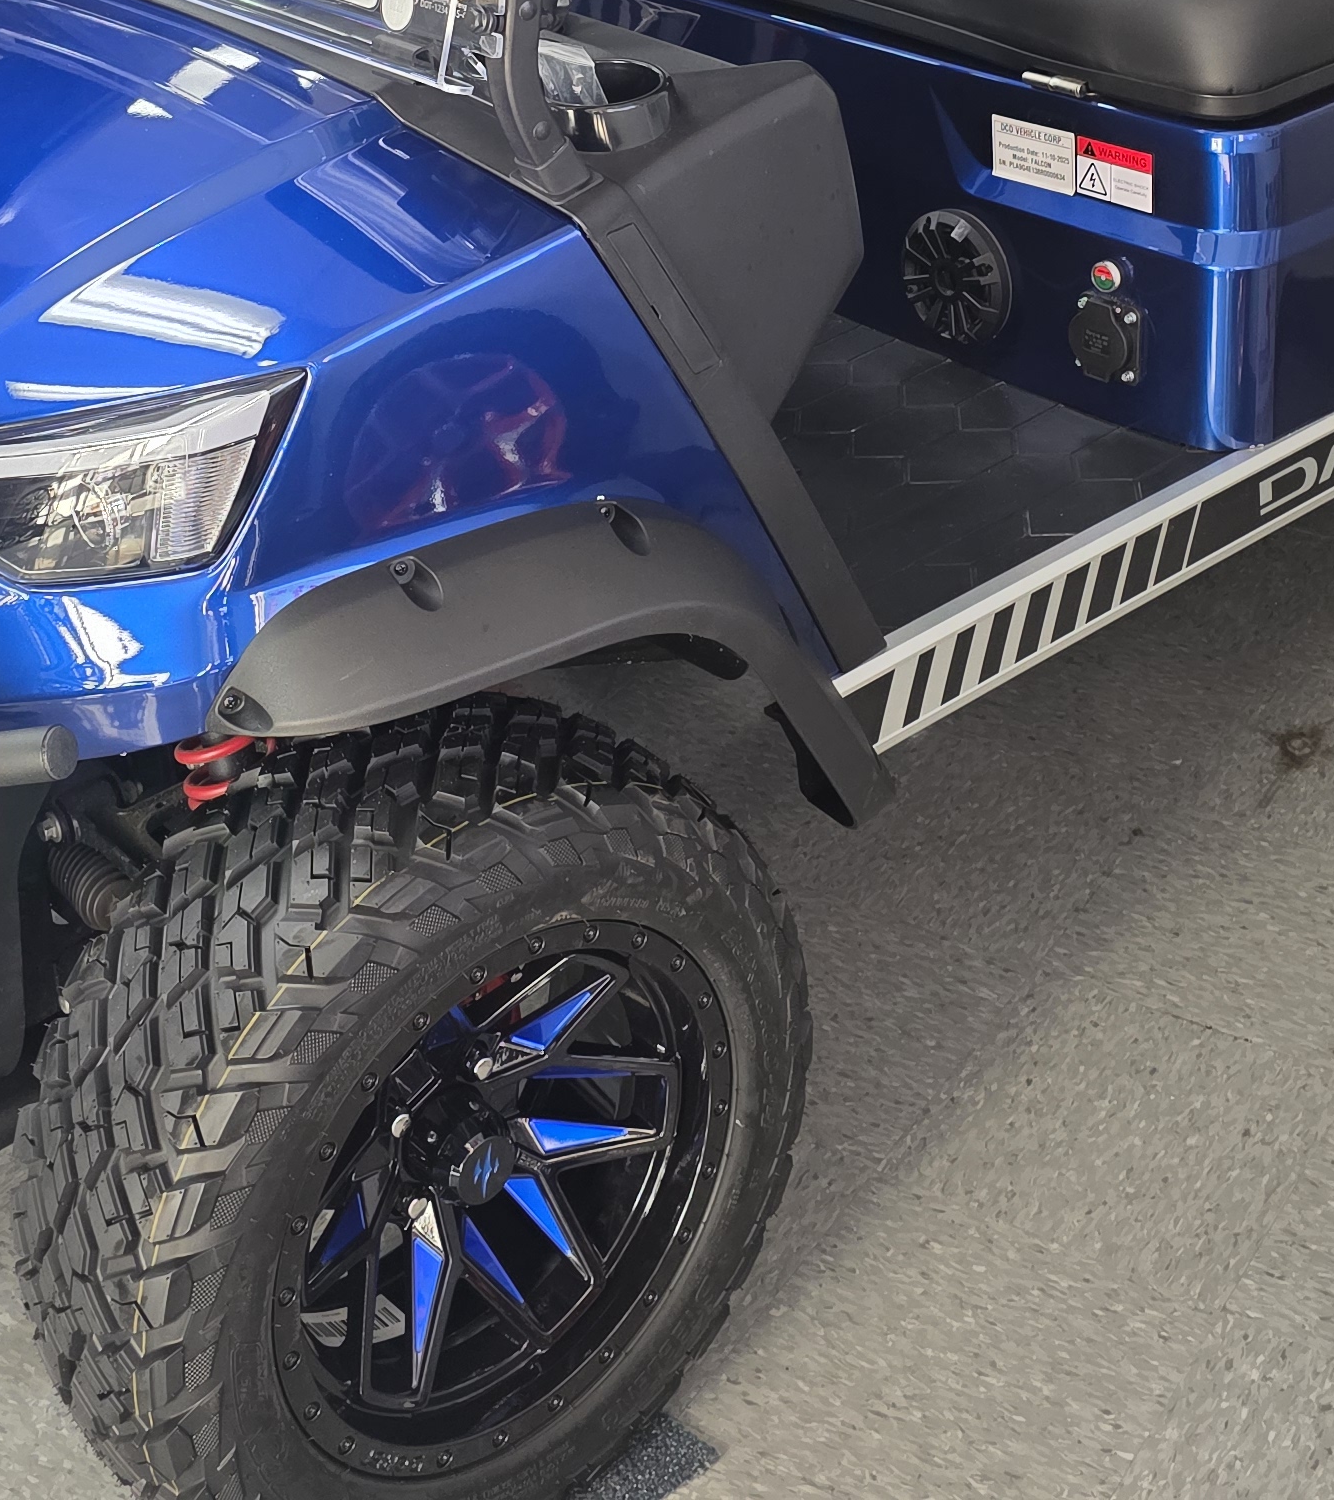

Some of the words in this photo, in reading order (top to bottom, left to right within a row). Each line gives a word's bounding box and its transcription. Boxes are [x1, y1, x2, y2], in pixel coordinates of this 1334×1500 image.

[1015, 126, 1042, 141] VEHICLE
[998, 141, 1025, 154] Production
[1030, 157, 1052, 169] FALCON
[1097, 145, 1147, 169] WARNING
